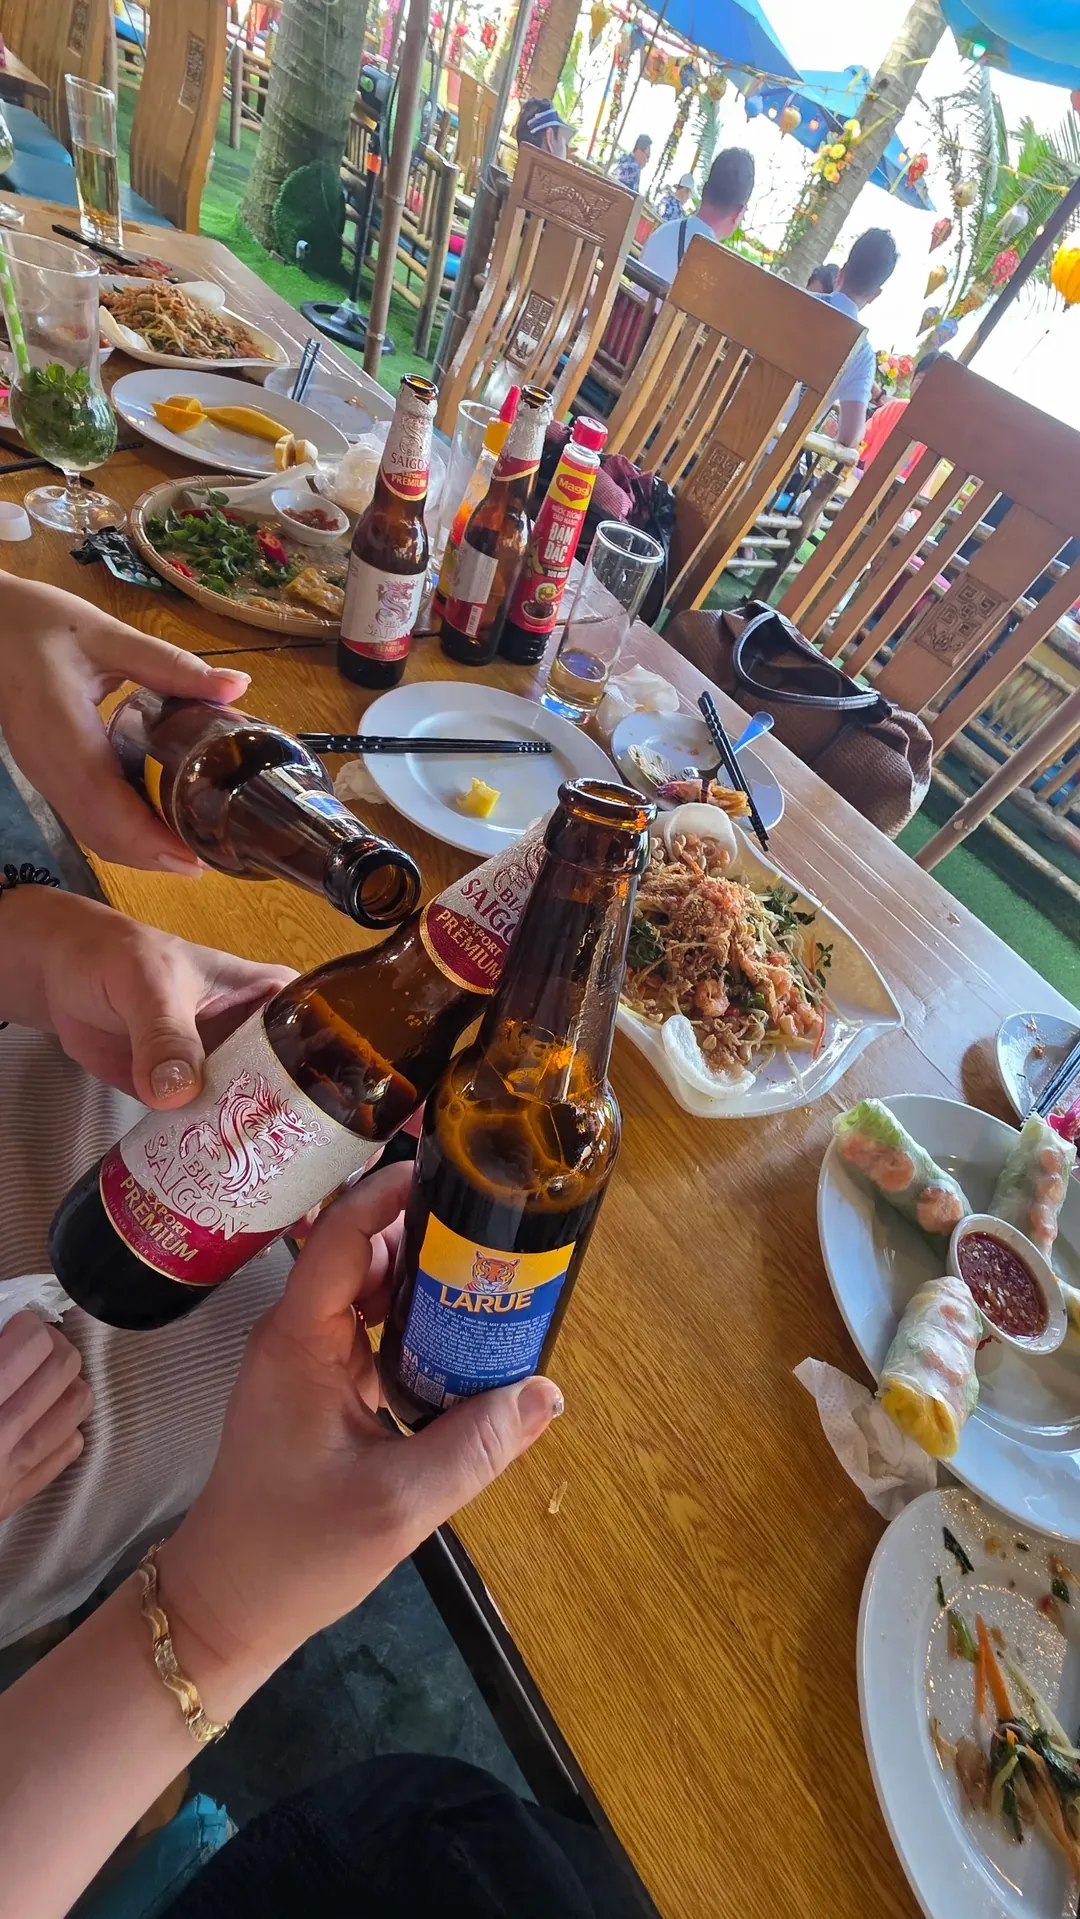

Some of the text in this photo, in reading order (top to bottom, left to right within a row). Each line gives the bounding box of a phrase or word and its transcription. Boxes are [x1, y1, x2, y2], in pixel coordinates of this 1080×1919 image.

[391, 452, 428, 470] SAIGO
[558, 477, 589, 497] Magg
[460, 878, 517, 946] SAIGO
[435, 909, 503, 981] PREMIUM
[463, 914, 503, 957] EXPORT
[144, 1130, 249, 1241] SAIGON
[182, 1155, 220, 1199] BIA
[120, 1174, 199, 1262] PREMIUM
[144, 1188, 192, 1237] EXPORT
[127, 1232, 149, 1256] LAGER
[440, 1285, 535, 1314] LARUE
[403, 1345, 419, 1367] BIA
